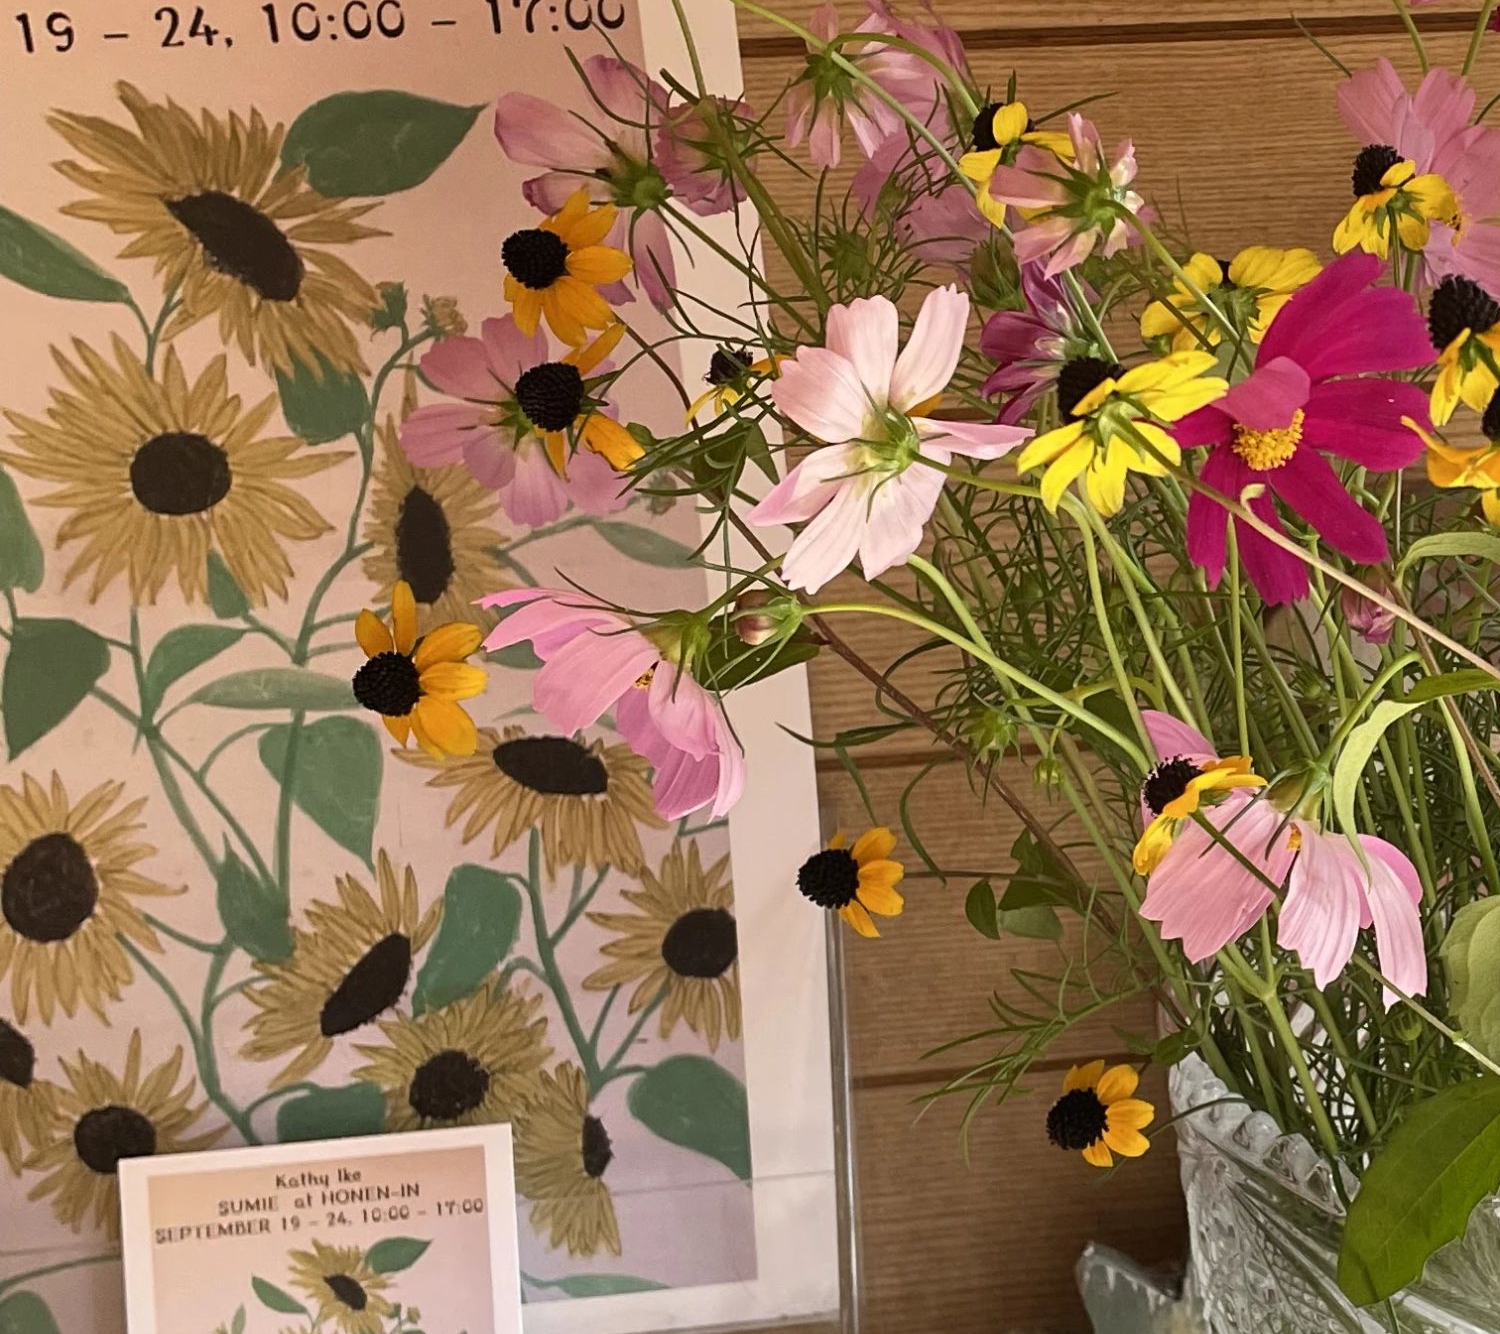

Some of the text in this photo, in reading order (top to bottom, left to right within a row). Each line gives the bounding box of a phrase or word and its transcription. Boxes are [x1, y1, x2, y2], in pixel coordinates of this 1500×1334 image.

[15, 11, 75, 54] 19
[154, 6, 234, 48] 24,
[261, 0, 405, 44] 10:00
[275, 1167, 362, 1189] Kathy Ike
[218, 1182, 420, 1217] SUMIE at HONEN-IN
[154, 1217, 272, 1245] SEPTEMBER
[281, 1215, 302, 1232] 19
[362, 1204, 410, 1224] 10:00
[437, 1197, 484, 1216] 17:00
